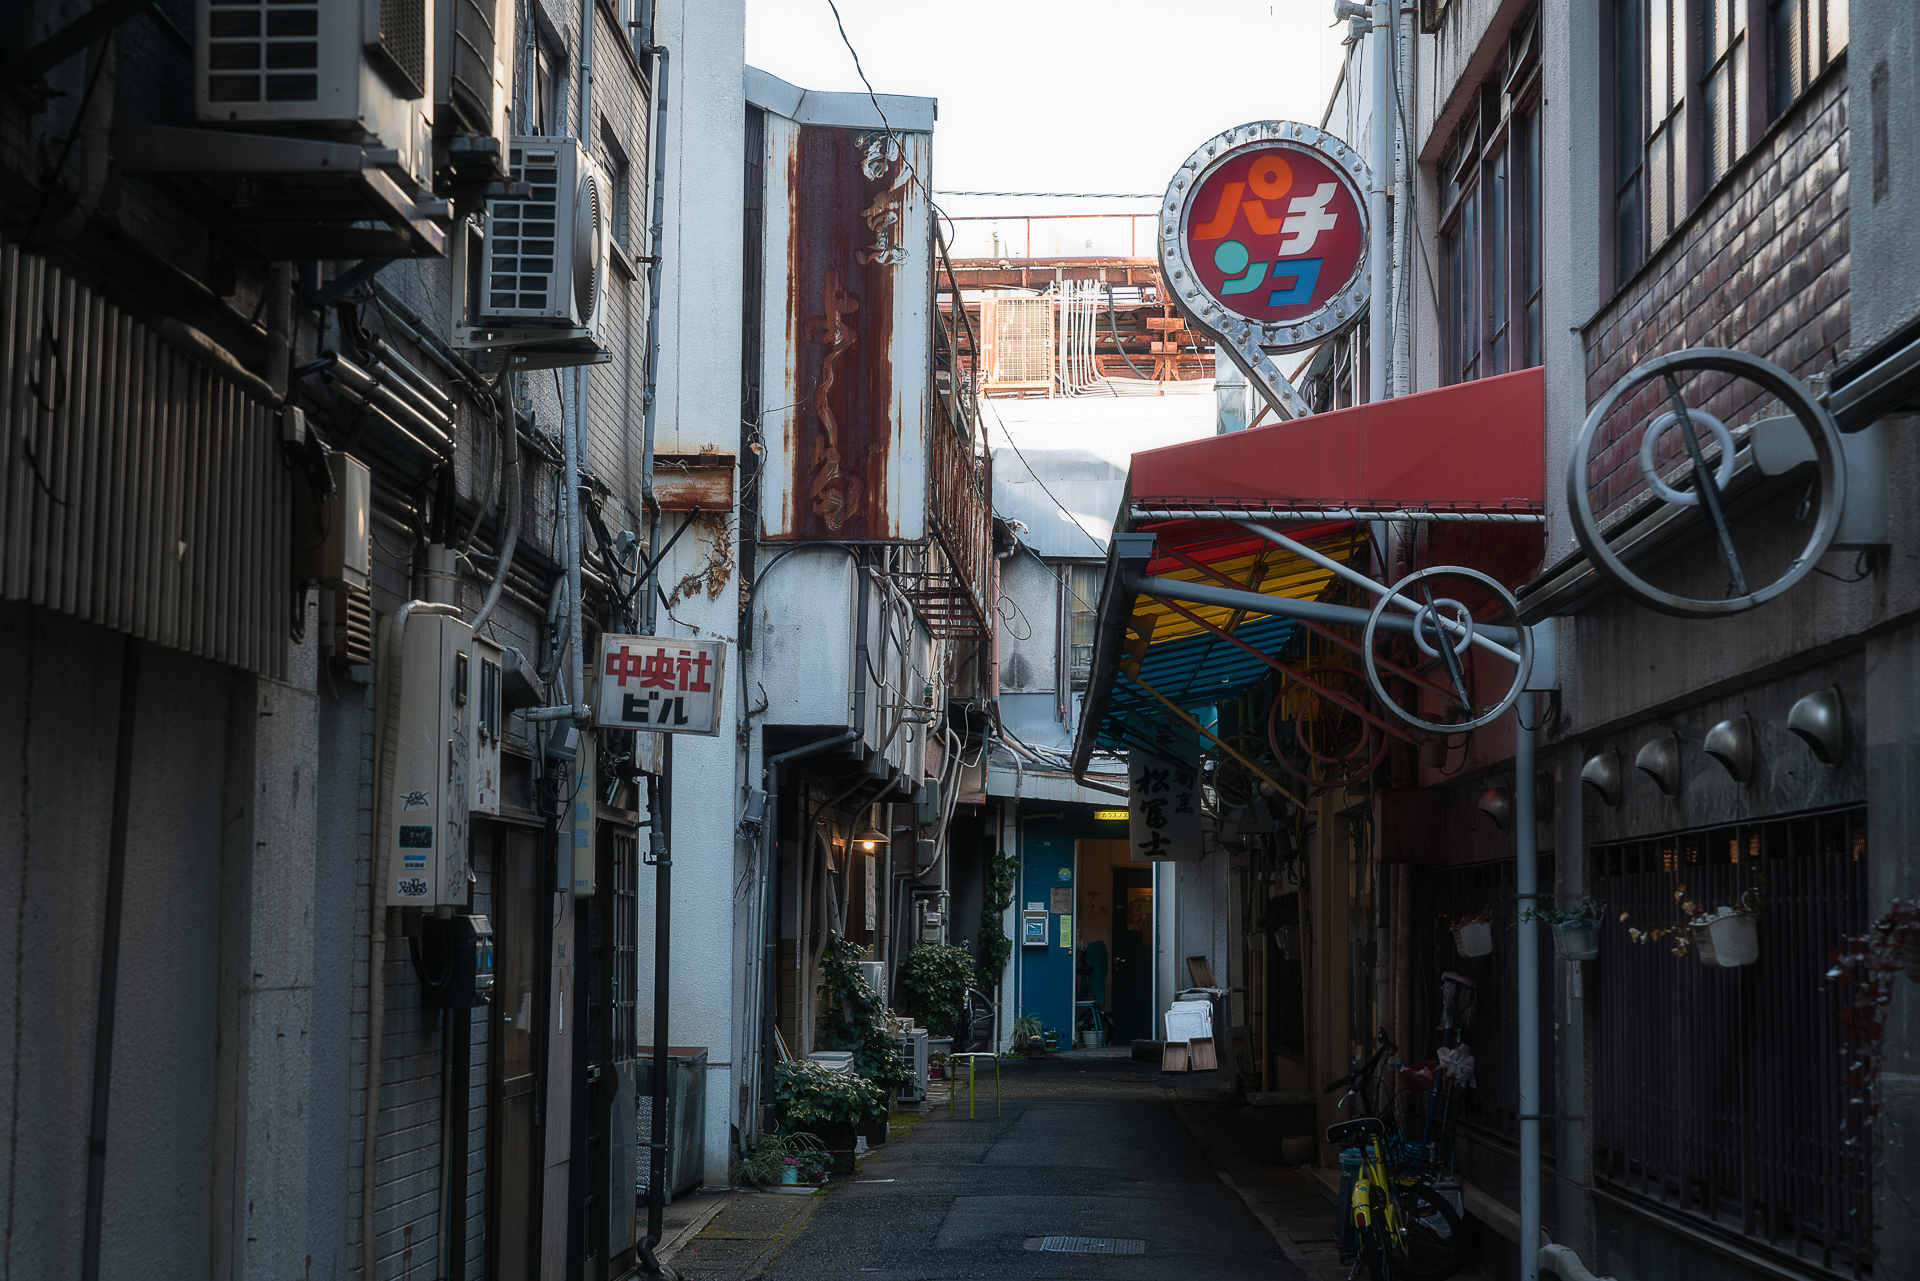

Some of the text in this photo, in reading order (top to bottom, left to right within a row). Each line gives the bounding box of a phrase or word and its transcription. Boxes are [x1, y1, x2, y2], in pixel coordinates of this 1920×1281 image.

[606, 646, 712, 693] 中央社
[622, 691, 688, 725] ビル
[575, 776, 590, 848] 不動産
